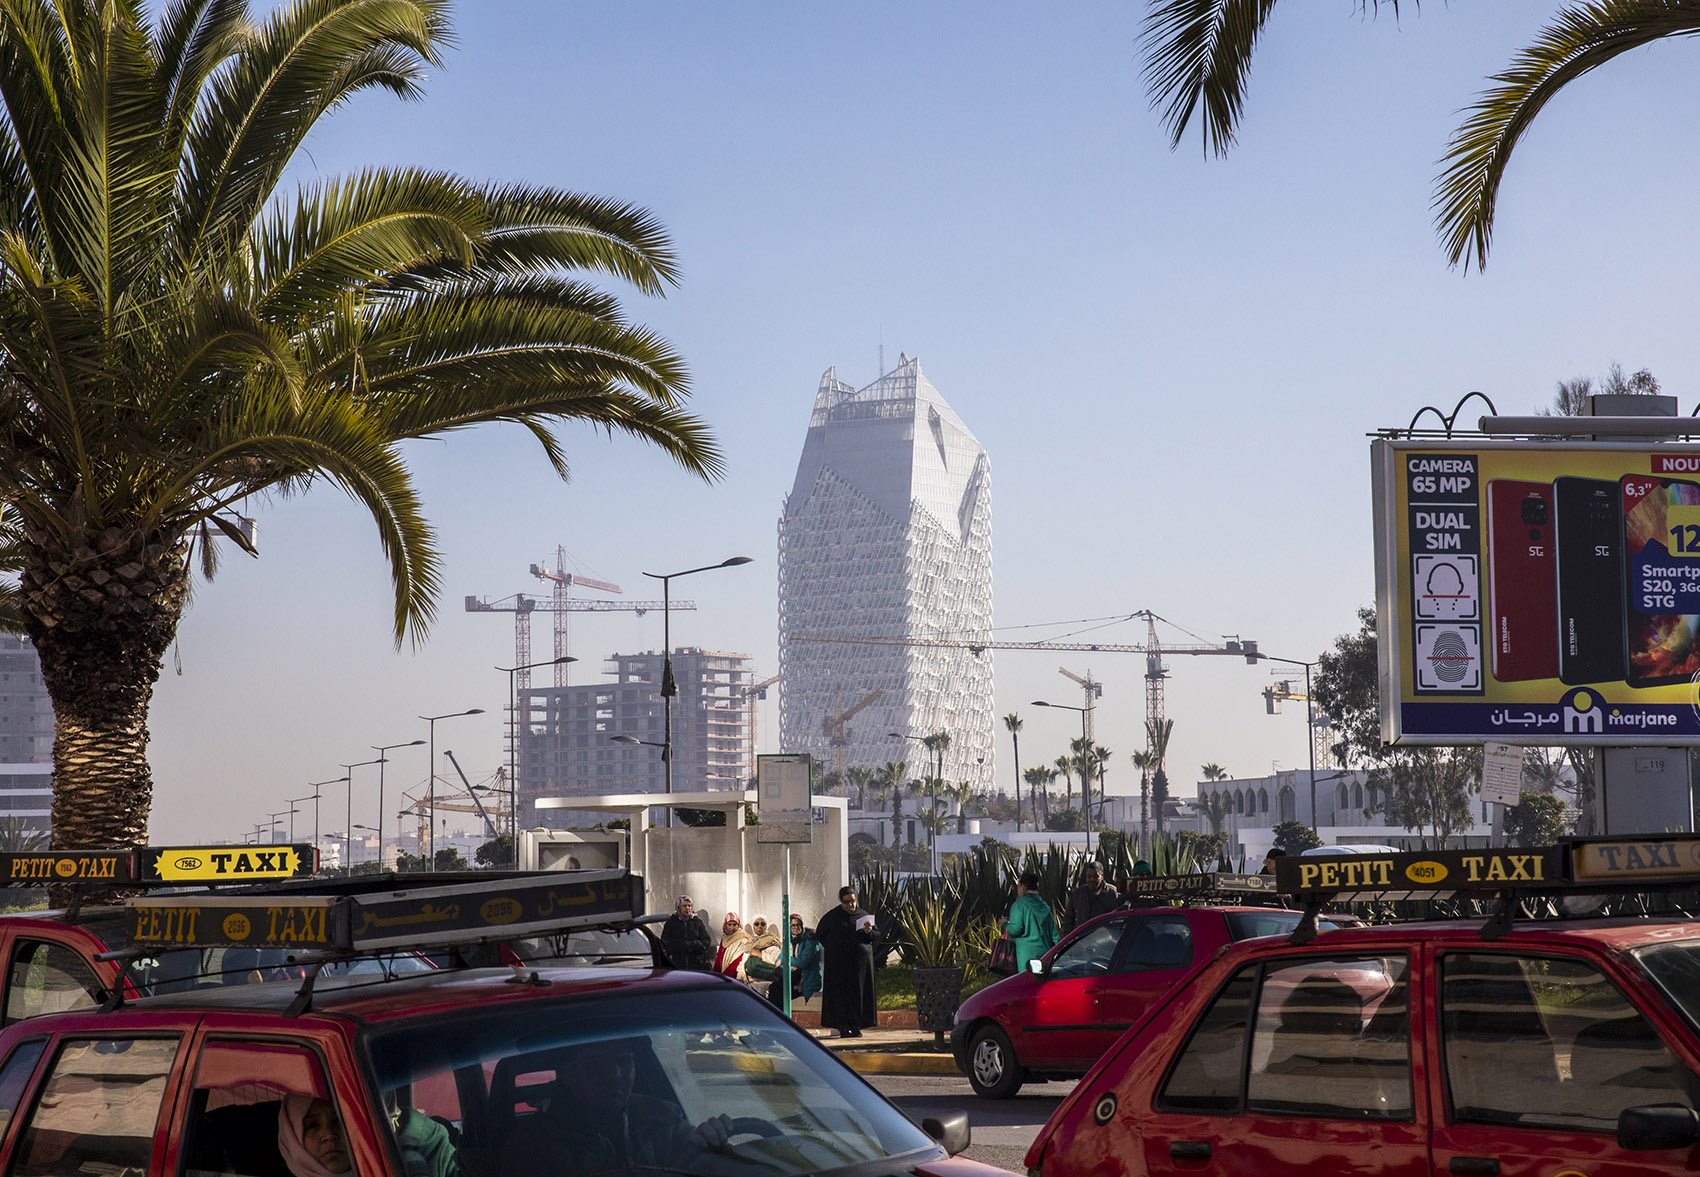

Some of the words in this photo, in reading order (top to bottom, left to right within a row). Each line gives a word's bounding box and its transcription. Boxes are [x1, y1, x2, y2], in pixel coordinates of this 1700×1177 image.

[1408, 459, 1474, 473] CAMERA
[1662, 458, 1700, 471] NOU
[1412, 476, 1436, 493] 65
[1440, 476, 1471, 493] MP
[1416, 512, 1471, 529] DUAL
[1425, 532, 1461, 550] SIM
[1642, 580, 1677, 595] S20,
[1643, 595, 1675, 608] STG
[1490, 709, 1560, 728] مرجان
[1608, 708, 1678, 729] marjane
[1650, 760, 1665, 769] 119
[181, 859, 196, 868] 7562
[210, 852, 289, 874] TAXI
[1599, 843, 1681, 871] TAXI
[10, 858, 55, 878] PETIT
[60, 863, 73, 872] 7562
[78, 857, 118, 878] TAXI
[1299, 860, 1394, 889] PETIT
[1413, 866, 1436, 878] 4051
[1462, 855, 1545, 882] TAXI
[1136, 879, 1165, 892] PETIT
[1178, 876, 1204, 889] TAXI
[134, 907, 201, 943] PETIT
[266, 907, 327, 943] TAXI
